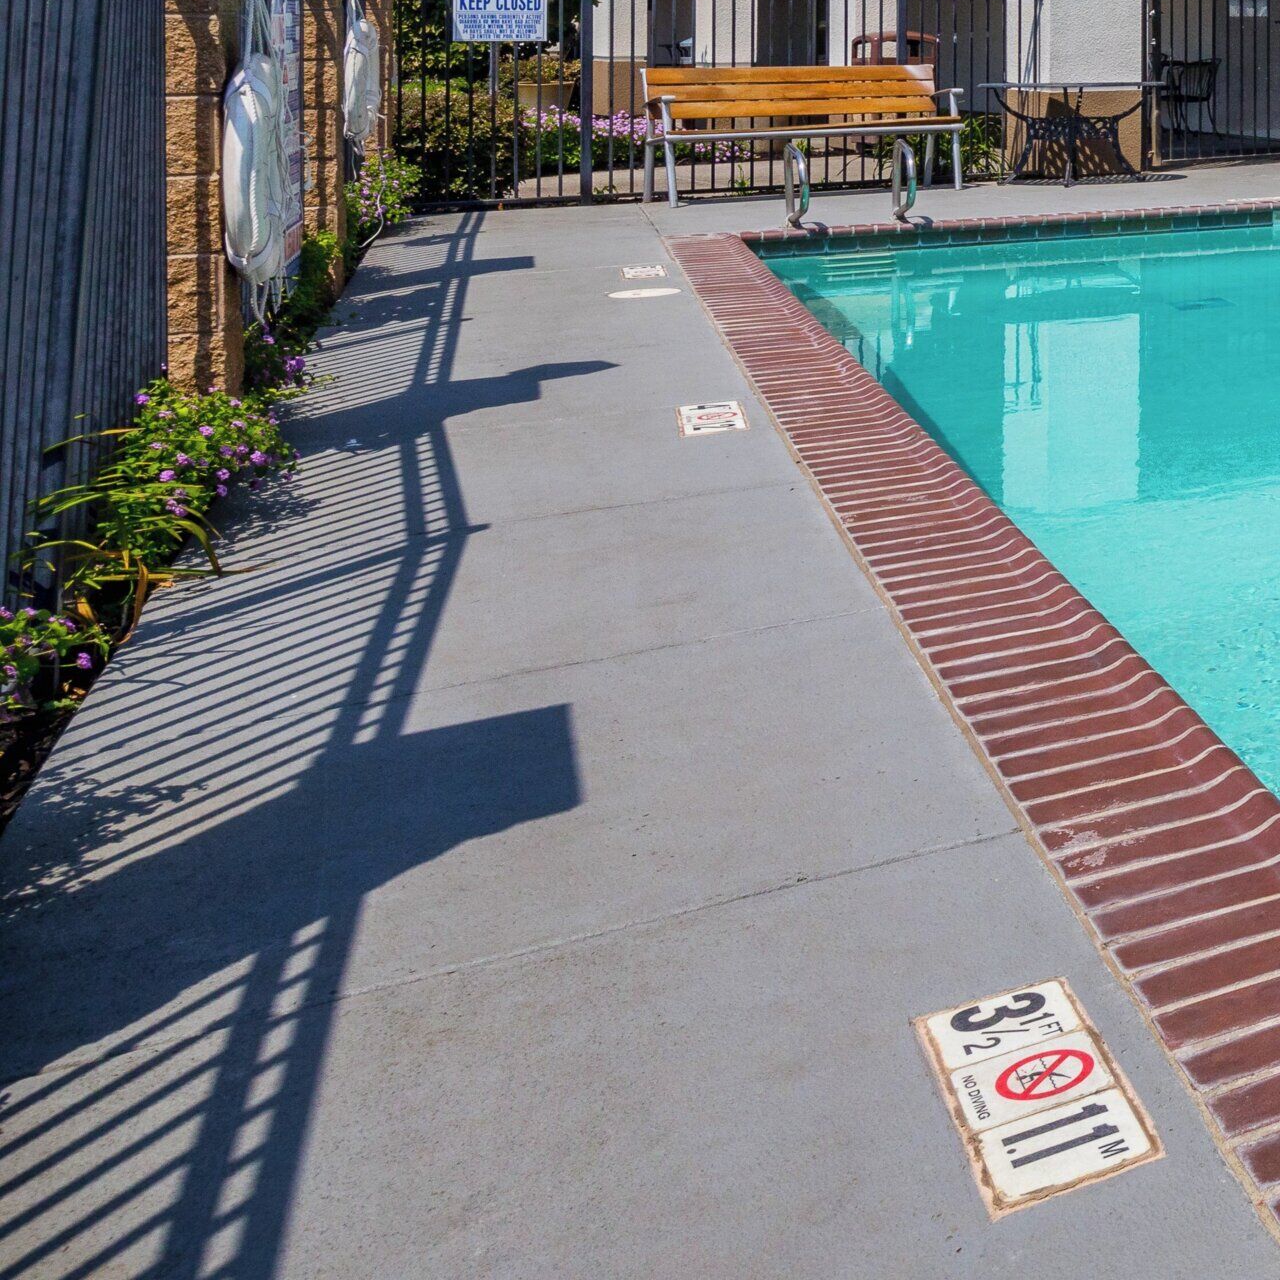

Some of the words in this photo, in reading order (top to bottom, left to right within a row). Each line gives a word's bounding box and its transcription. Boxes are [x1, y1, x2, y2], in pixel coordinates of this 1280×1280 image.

[1038, 1021, 1064, 1036] FT
[962, 1075, 978, 1091] NO
[968, 1089, 991, 1121] DIVING
[1001, 1103, 1120, 1169] 1.1
[1098, 1138, 1130, 1159] M
